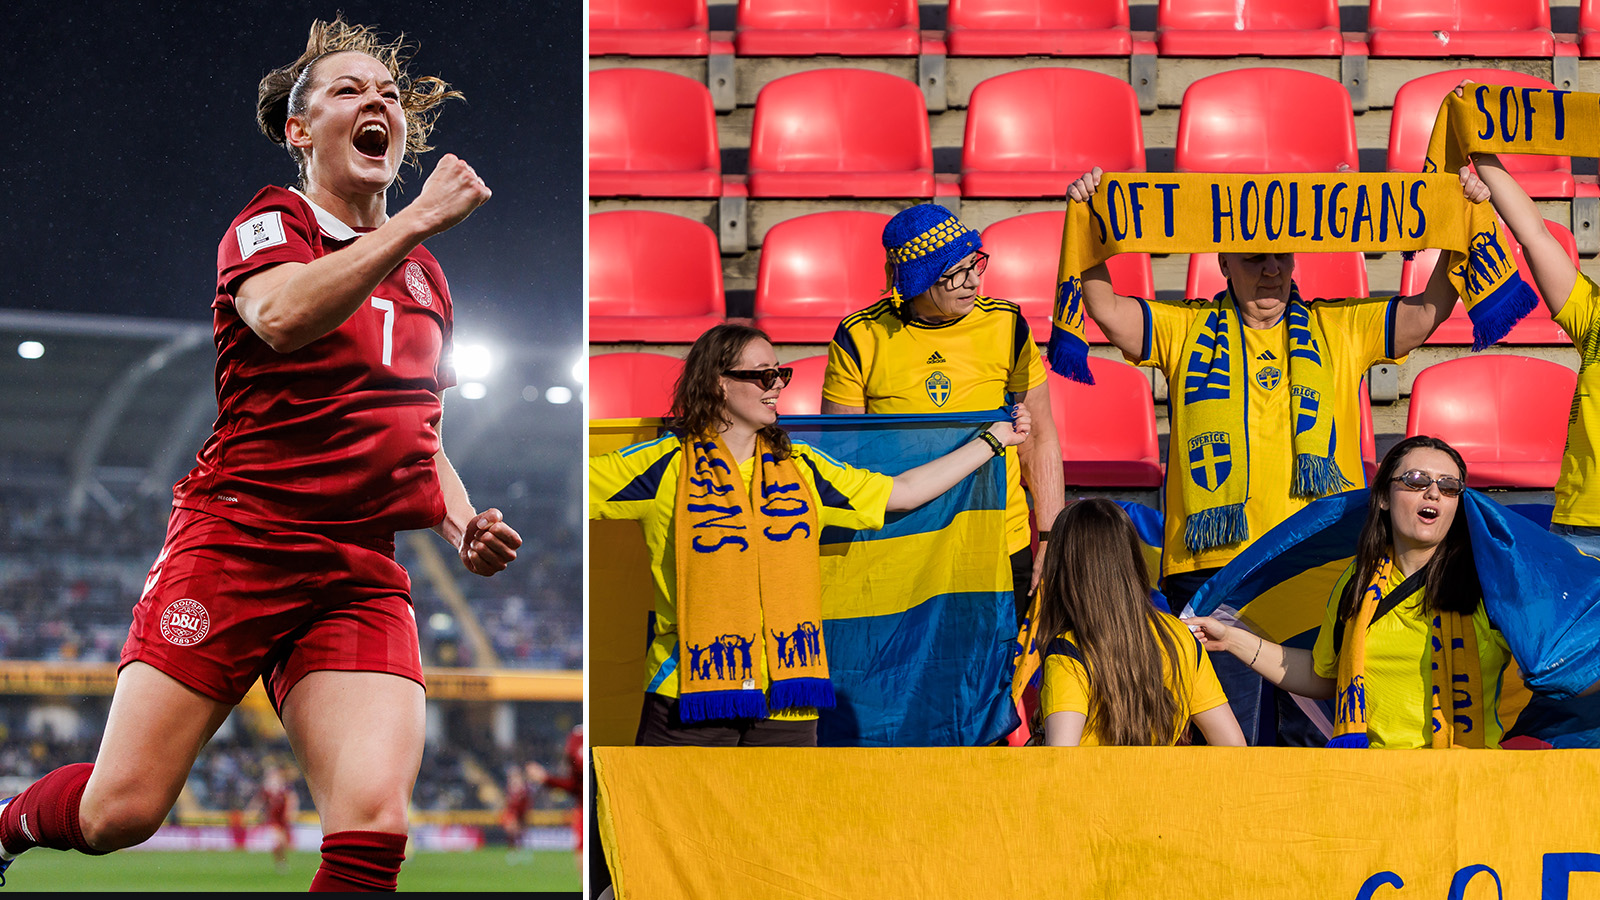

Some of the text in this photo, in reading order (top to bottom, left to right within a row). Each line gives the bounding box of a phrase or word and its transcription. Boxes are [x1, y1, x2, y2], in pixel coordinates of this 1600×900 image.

[1475, 85, 1572, 143] SOFT
[1087, 180, 1427, 245] SOFT HOOLIGANS
[371, 296, 395, 367] 7
[1293, 387, 1315, 399] RIGE
[1191, 433, 1225, 449] SVERIGE
[760, 452, 811, 542] SOF
[162, 608, 174, 636] DANSK
[192, 619, 208, 641] UNION
[170, 613, 200, 631] DBU
